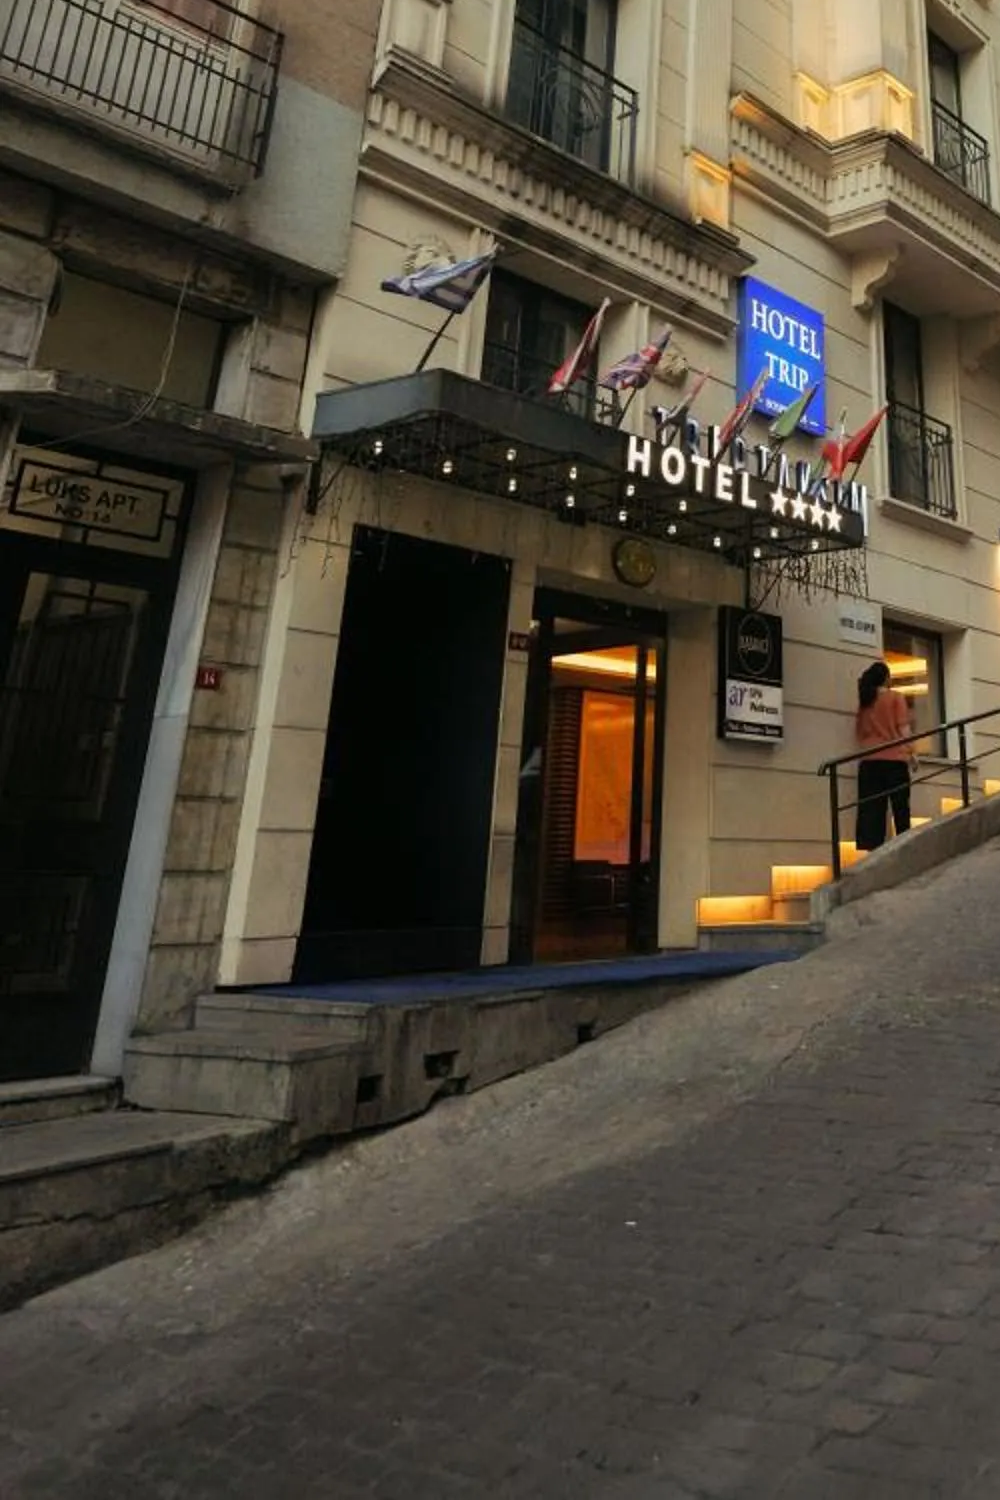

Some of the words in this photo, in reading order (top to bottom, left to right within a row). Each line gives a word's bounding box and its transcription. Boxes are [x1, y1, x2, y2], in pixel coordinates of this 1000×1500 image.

[751, 298, 821, 361] HOTEL
[764, 350, 809, 394] TRIP
[627, 435, 757, 510] HOTEL
